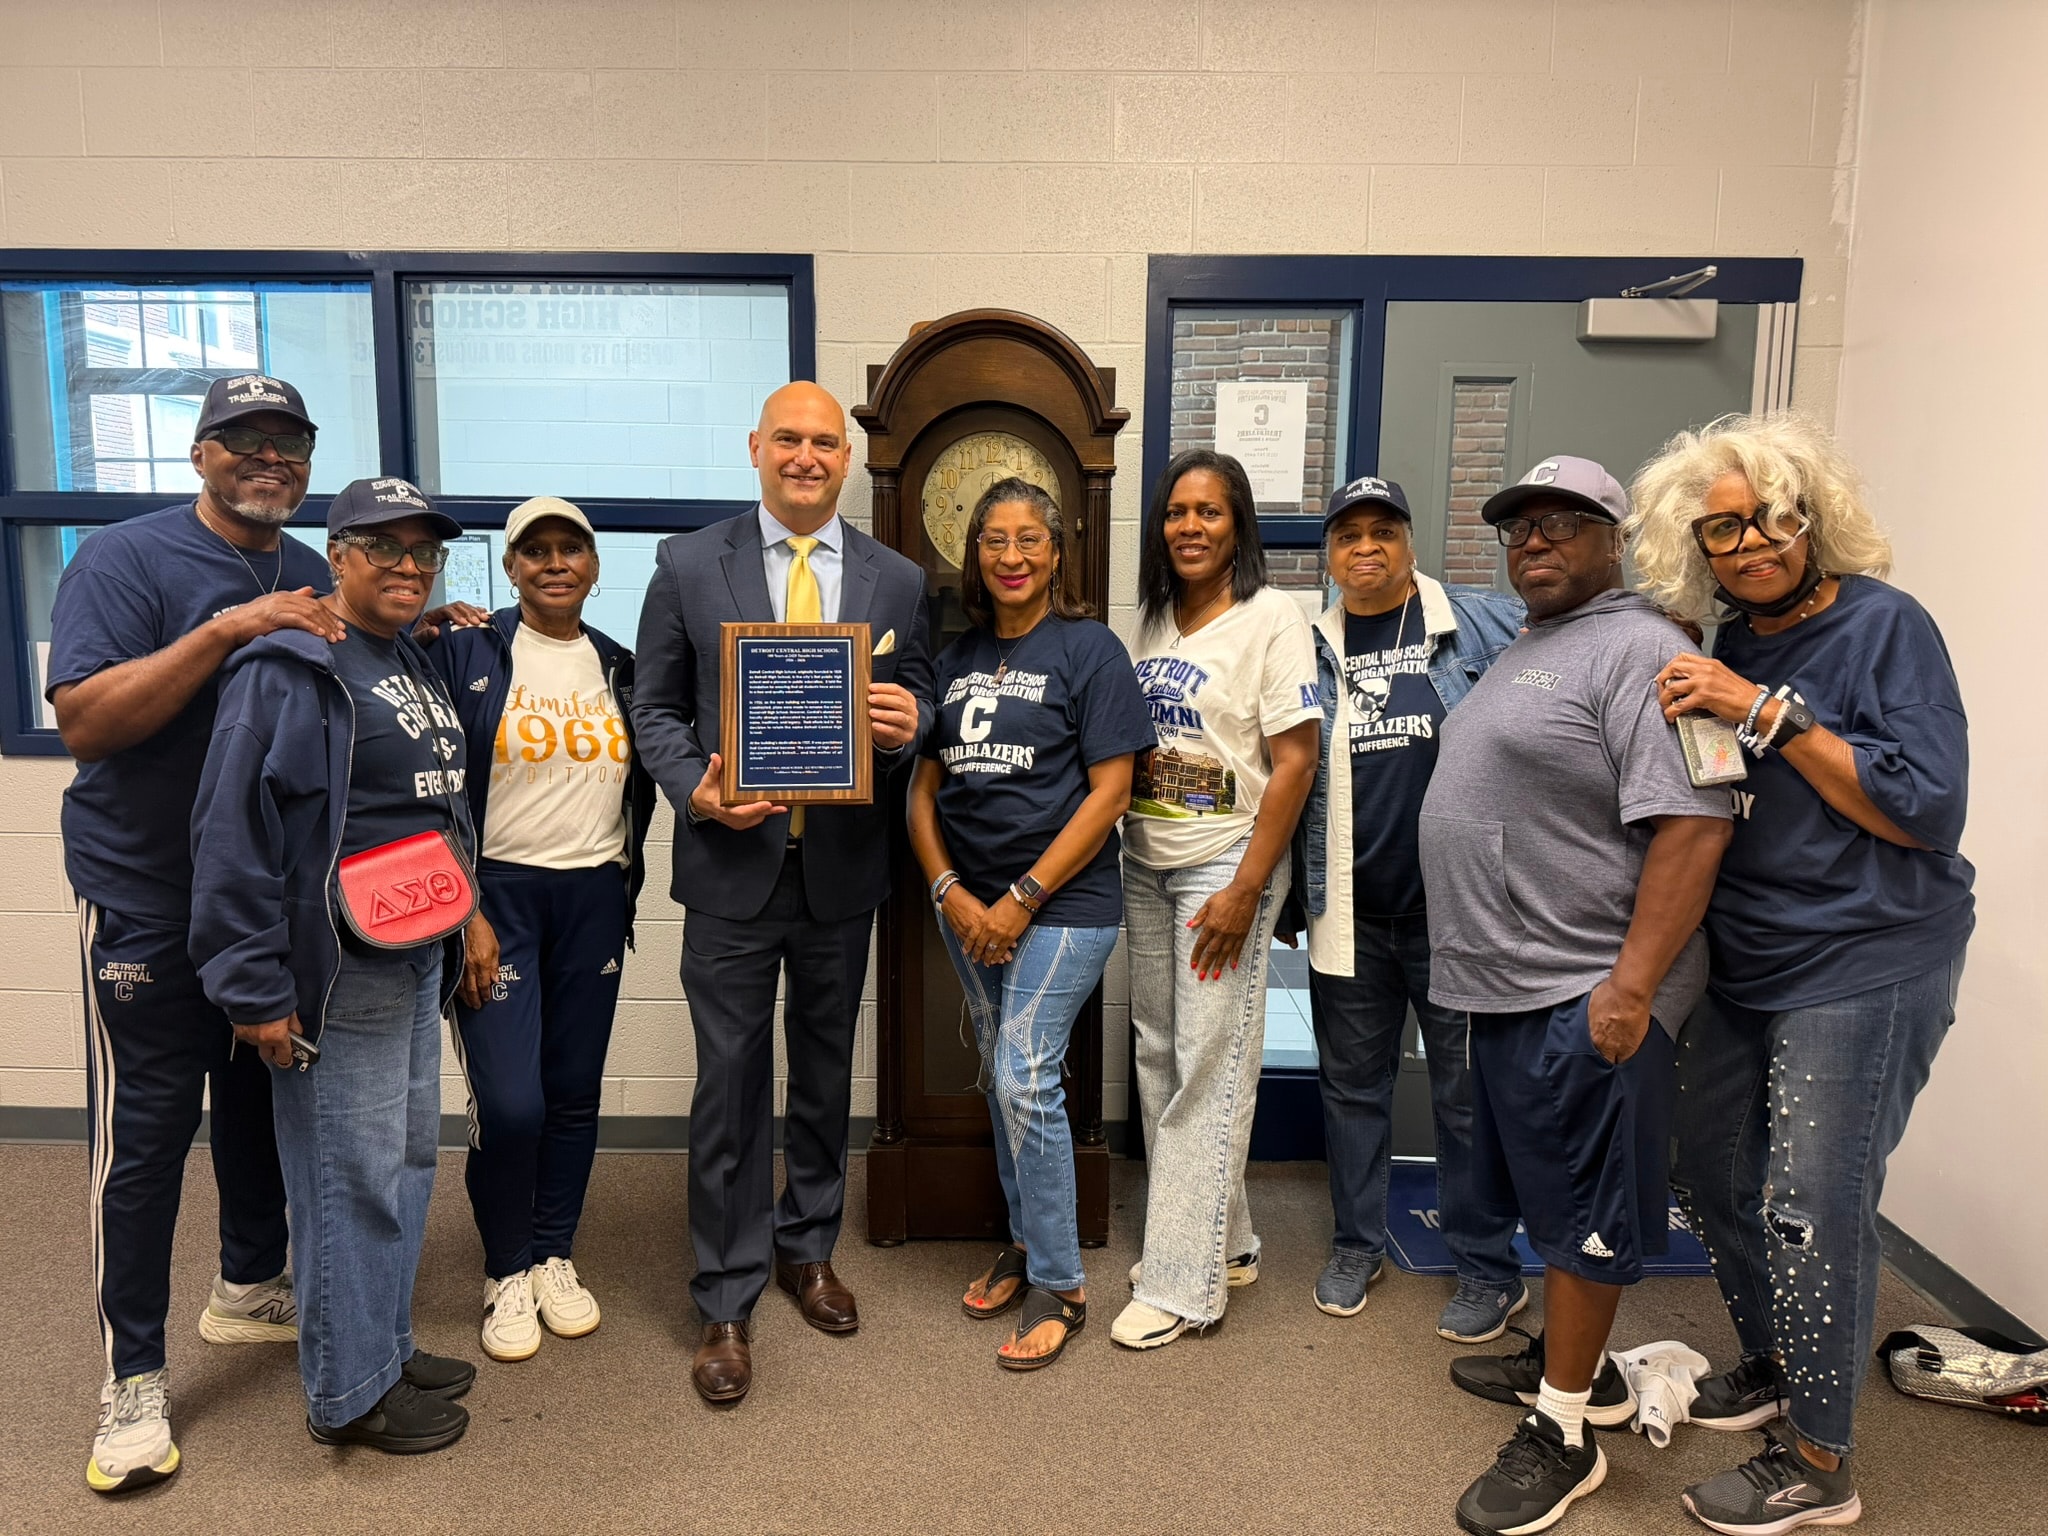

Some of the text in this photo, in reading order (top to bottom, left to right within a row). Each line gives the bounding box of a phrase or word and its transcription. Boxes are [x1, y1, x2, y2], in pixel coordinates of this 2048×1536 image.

[959, 448, 974, 470] 11
[985, 441, 1002, 464] 12
[1016, 449, 1023, 470] 1
[940, 468, 958, 489] 10
[1530, 462, 1560, 485] C
[936, 495, 947, 516] 9
[942, 523, 954, 544] 8
[1345, 644, 1429, 672] CENTRAL HIGH SCHO
[1016, 671, 1048, 687] SCHOOL
[1134, 656, 1209, 696] DETROIT
[1352, 660, 1428, 681] ORGANIZATIO
[1141, 676, 1184, 699] Central
[505, 684, 614, 719] Limited
[959, 696, 998, 743] C
[1147, 702, 1203, 729] UMNI
[494, 714, 632, 764] 1968
[1159, 726, 1179, 737] 1981
[1351, 736, 1410, 754] A DIFFERENCE
[939, 743, 1035, 769] TRAILBLAZERS
[505, 766, 625, 785] EDITION
[99, 968, 154, 982] CENTRAL
[107, 962, 147, 971] DETROIT
[115, 981, 133, 1001] C
[491, 982, 508, 1001] C
[1581, 1244, 1615, 1257] adidas
